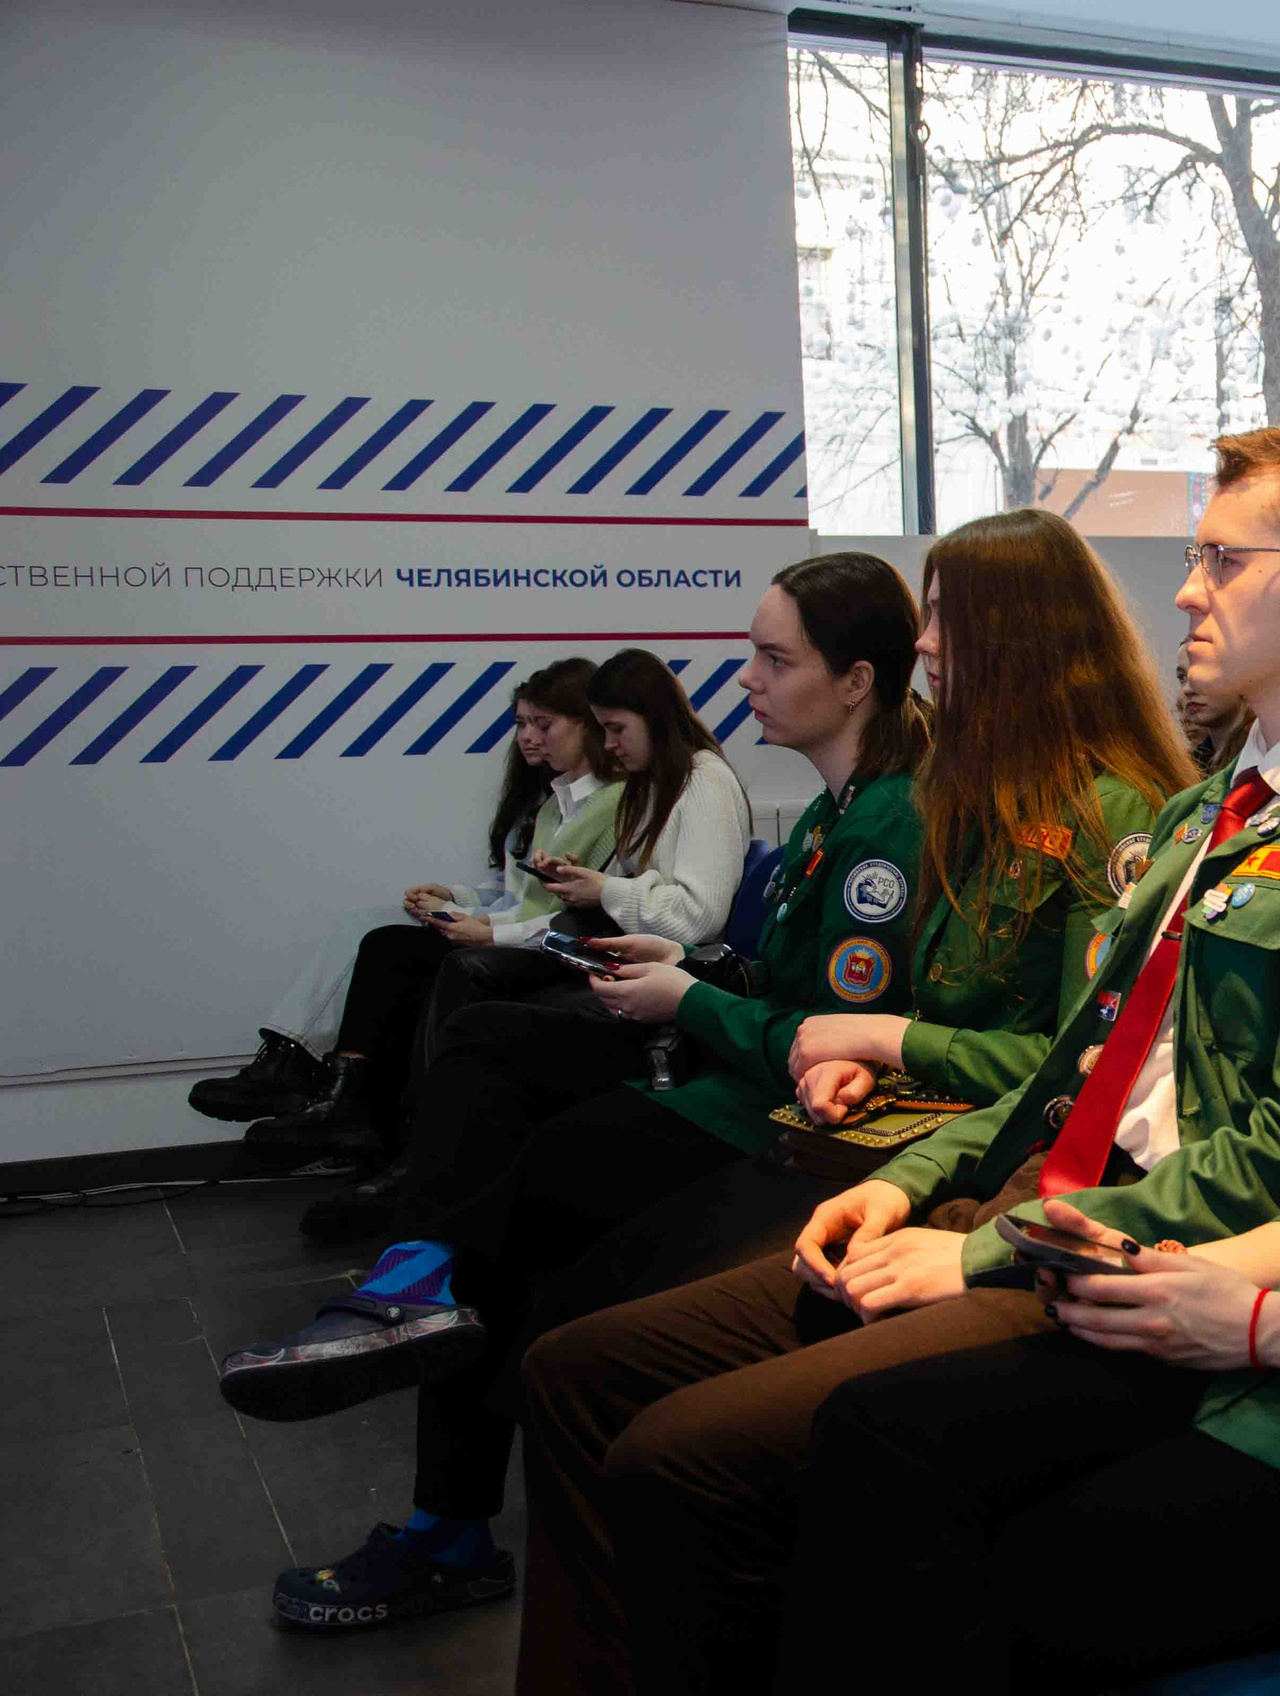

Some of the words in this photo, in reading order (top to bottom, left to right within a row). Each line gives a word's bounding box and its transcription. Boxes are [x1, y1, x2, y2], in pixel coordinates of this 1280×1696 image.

[185, 566, 383, 592] ПОДДЕРЖКИ
[396, 564, 607, 588] ЧЕЛЯБИНСКОЙ
[616, 569, 742, 588] ОБЛАСТИ
[309, 1604, 388, 1623] crocs
